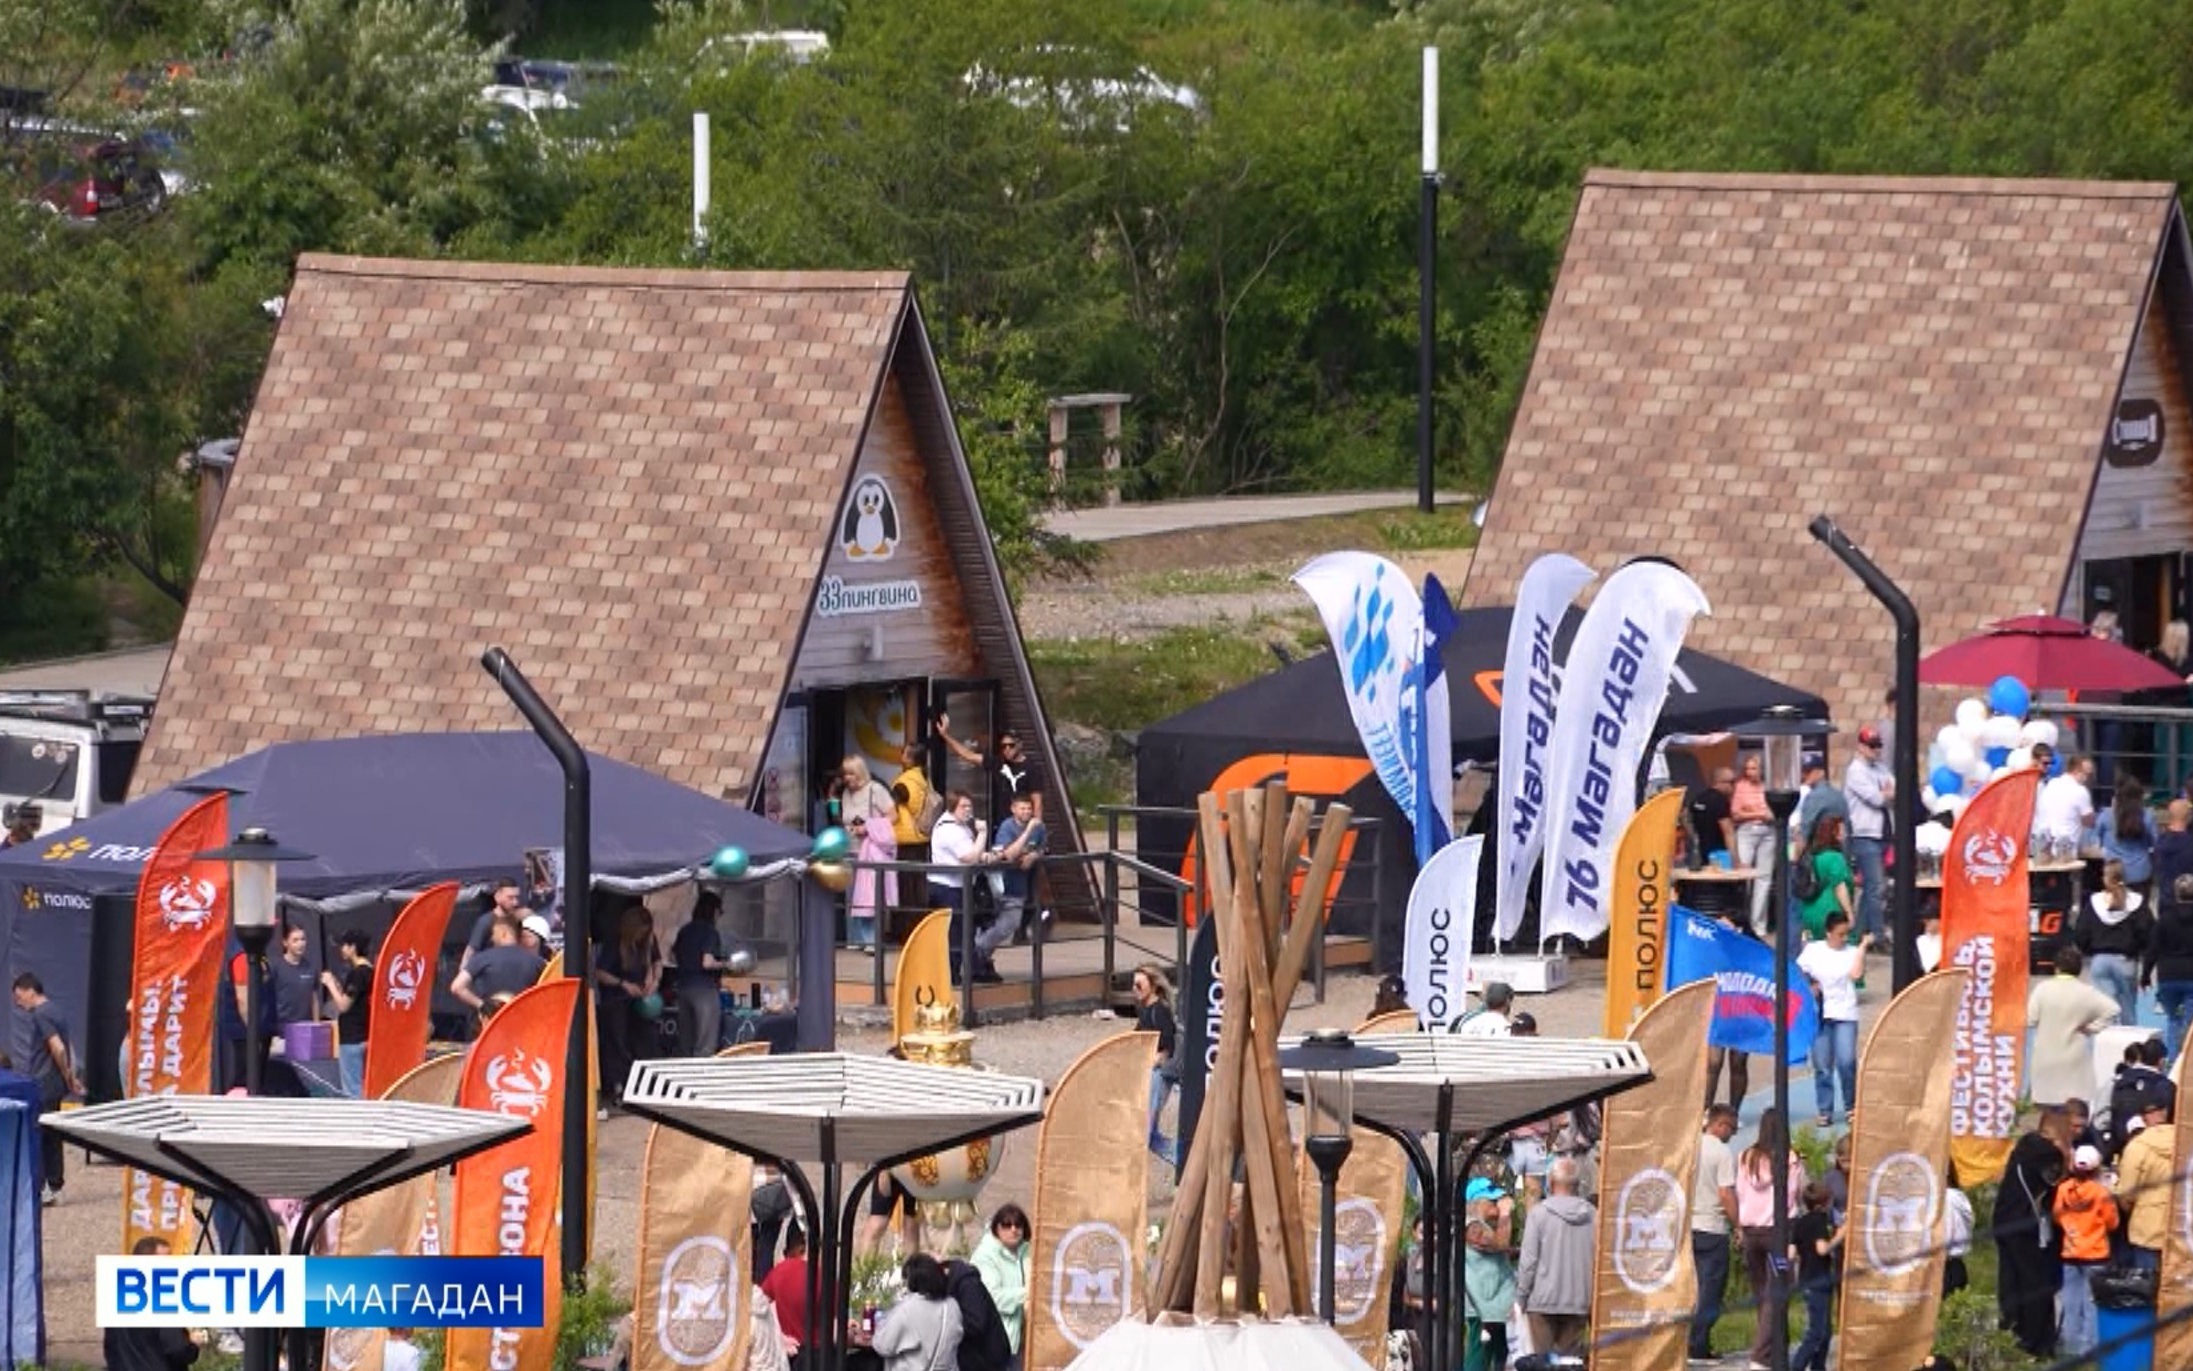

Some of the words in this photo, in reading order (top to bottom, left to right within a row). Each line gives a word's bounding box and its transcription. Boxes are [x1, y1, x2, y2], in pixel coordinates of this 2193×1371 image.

[1570, 617, 1649, 848] Магадан
[1564, 859, 1599, 911] 76
[1637, 860, 1658, 990] ПОЛЮС
